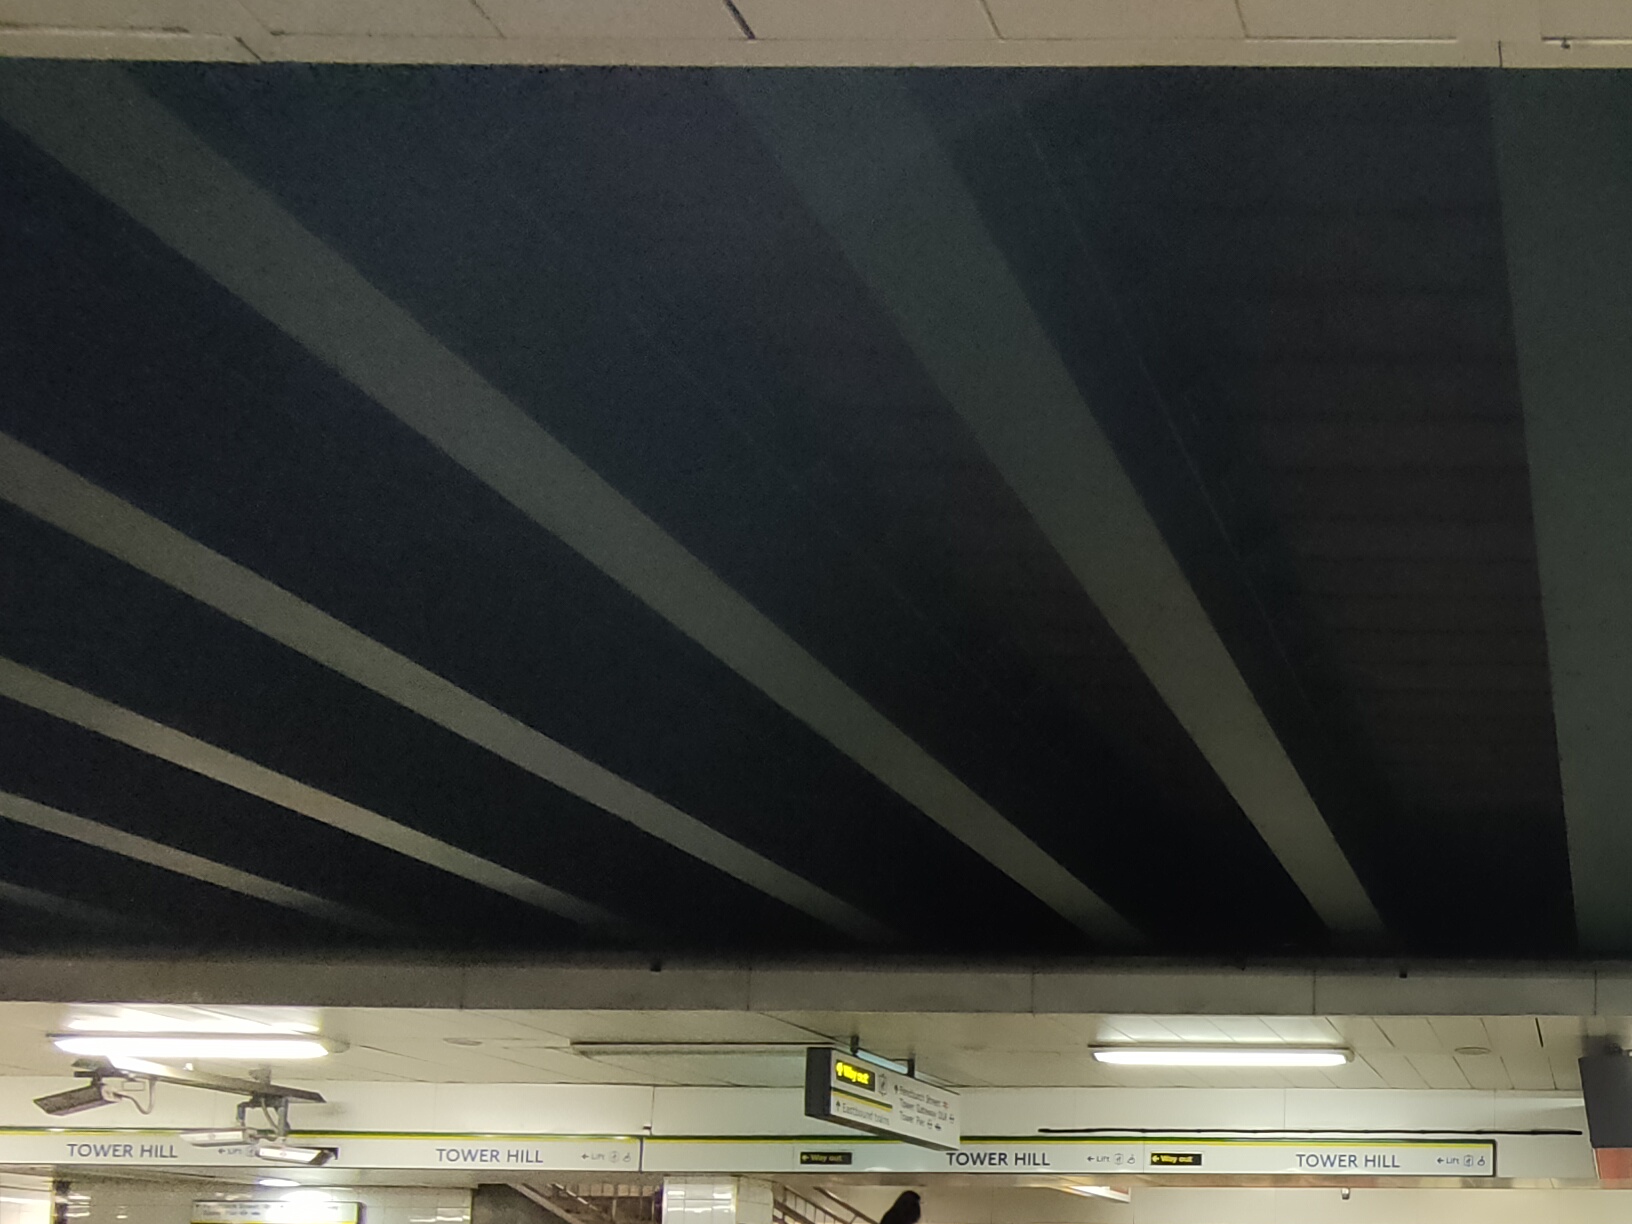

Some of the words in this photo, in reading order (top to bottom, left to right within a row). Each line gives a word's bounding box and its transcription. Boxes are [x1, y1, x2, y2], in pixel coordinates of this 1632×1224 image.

[842, 1103, 874, 1121] Eastbound
[67, 1144, 134, 1158] TOWER
[140, 1144, 178, 1158] HILL
[436, 1149, 500, 1162] TOWER
[506, 1149, 543, 1163] HILL
[946, 1152, 1009, 1166] TOWER
[1014, 1152, 1050, 1166] HILL
[1096, 1155, 1110, 1163] Lift
[1160, 1155, 1178, 1164] Way
[1179, 1155, 1193, 1163] out
[1296, 1154, 1358, 1168] TOWER
[1364, 1154, 1400, 1168] HILL
[1446, 1156, 1460, 1165] Lift
